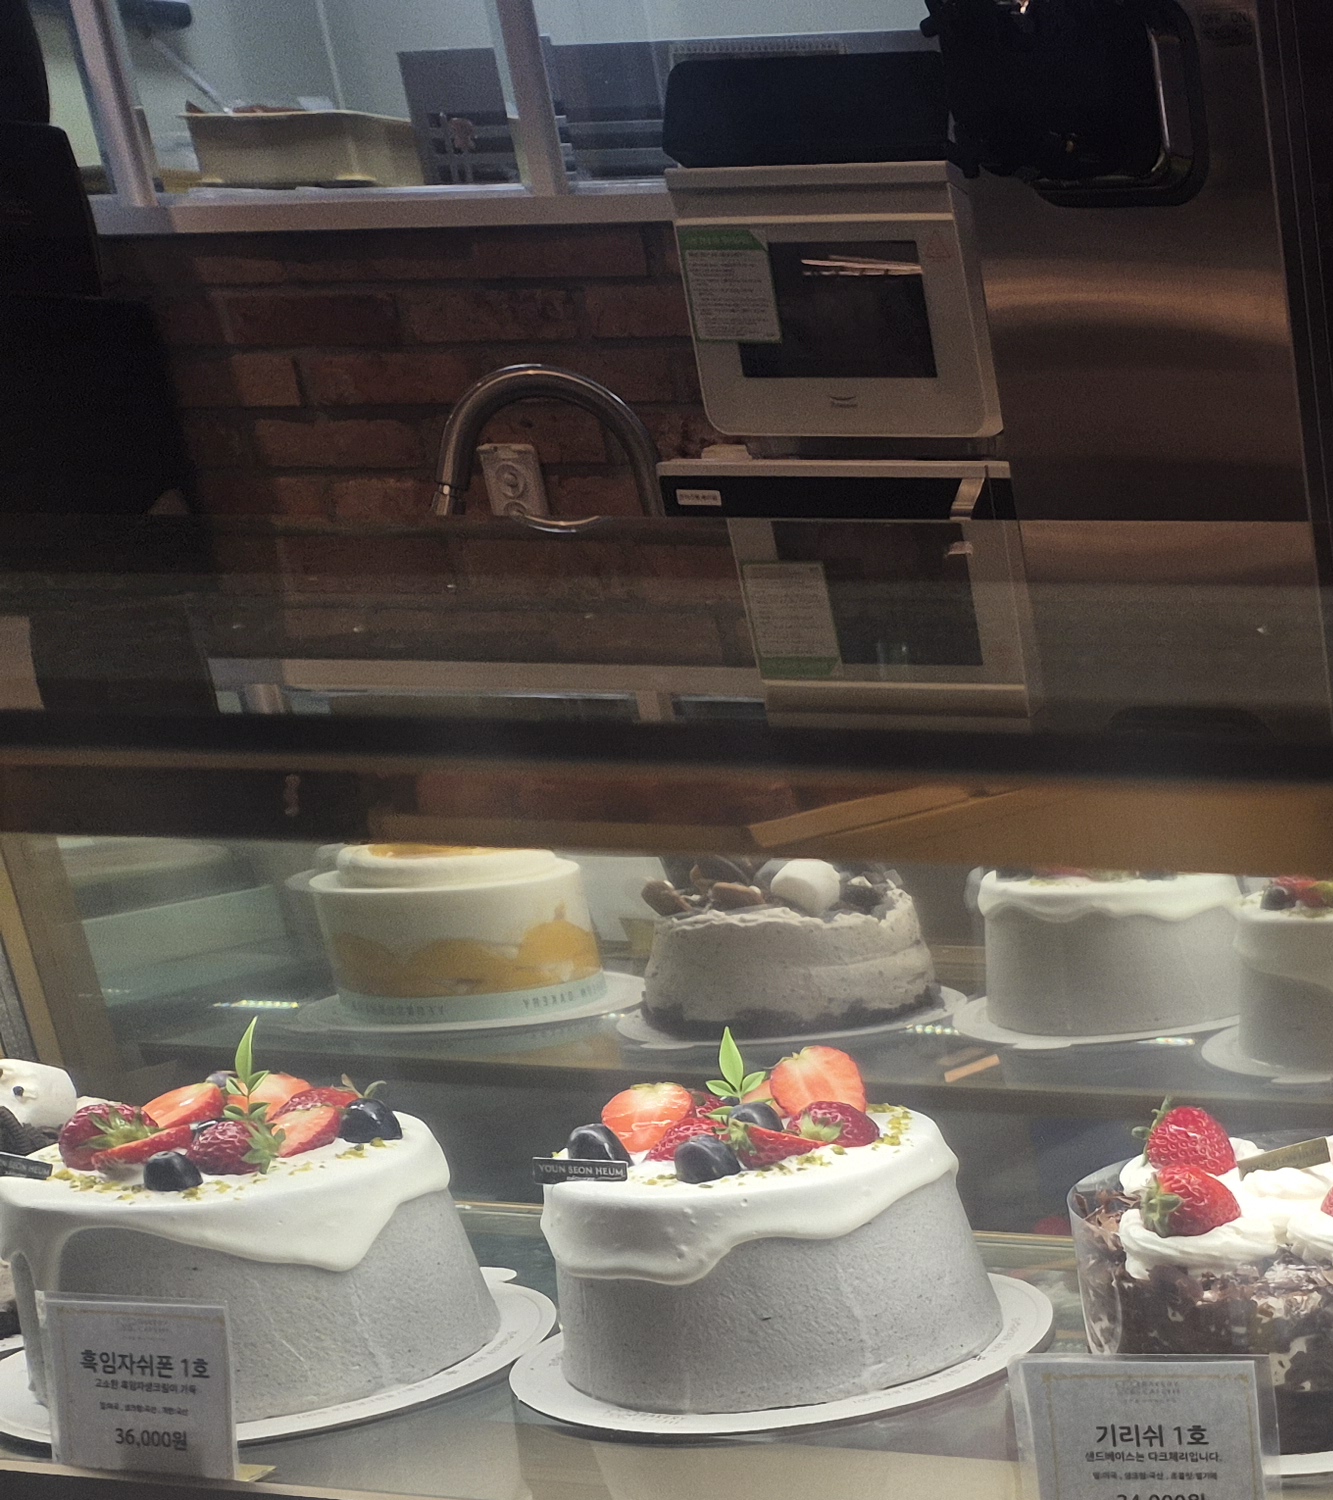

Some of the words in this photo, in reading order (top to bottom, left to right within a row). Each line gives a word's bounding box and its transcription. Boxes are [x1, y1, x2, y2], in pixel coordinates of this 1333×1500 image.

[538, 1164, 566, 1174] YOUN
[568, 1165, 593, 1175] SEON
[595, 1166, 626, 1177] HEUM
[80, 1349, 175, 1379] 흑임자쉬폰
[181, 1358, 211, 1379] 1호
[115, 1428, 188, 1451] 36,000원
[1095, 1423, 1165, 1448] 기리쉬
[1173, 1424, 1209, 1447] 1호
[1084, 1451, 1145, 1463] 샌드베이스는
[1147, 1452, 1223, 1463] 다크체리입니다.
